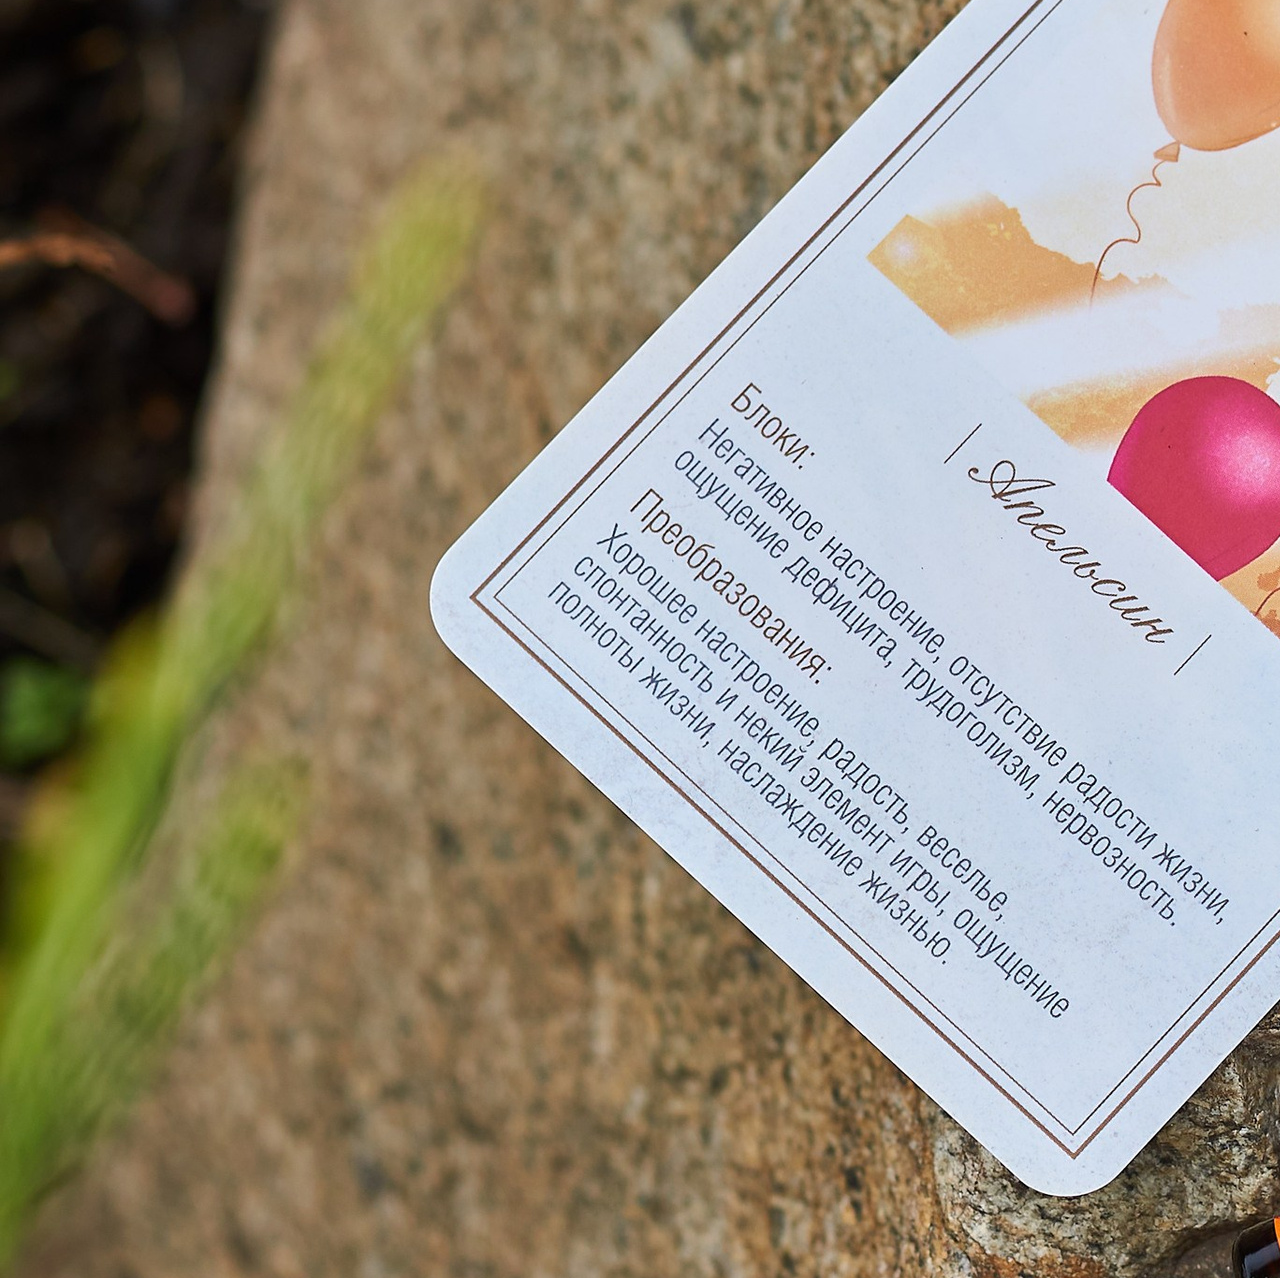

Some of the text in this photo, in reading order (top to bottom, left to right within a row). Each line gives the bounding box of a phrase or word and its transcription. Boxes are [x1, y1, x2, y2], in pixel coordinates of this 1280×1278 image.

[628, 487, 832, 685] Преобразования:
[729, 381, 815, 470] Блоки:
[966, 458, 1175, 644] Апельсин
[546, 580, 951, 965] полноты жизни, наслаждение жизнью.
[572, 555, 1070, 1019] спонтанность и некий элемент игры, ощущение
[595, 521, 1008, 922] Хорошее настроение, радость, веселье,
[673, 449, 1176, 927] ощущение дефицита, трудоголизм, нервозность.
[696, 416, 1230, 926] Негативное настроение, отсутствие радости жизни,
